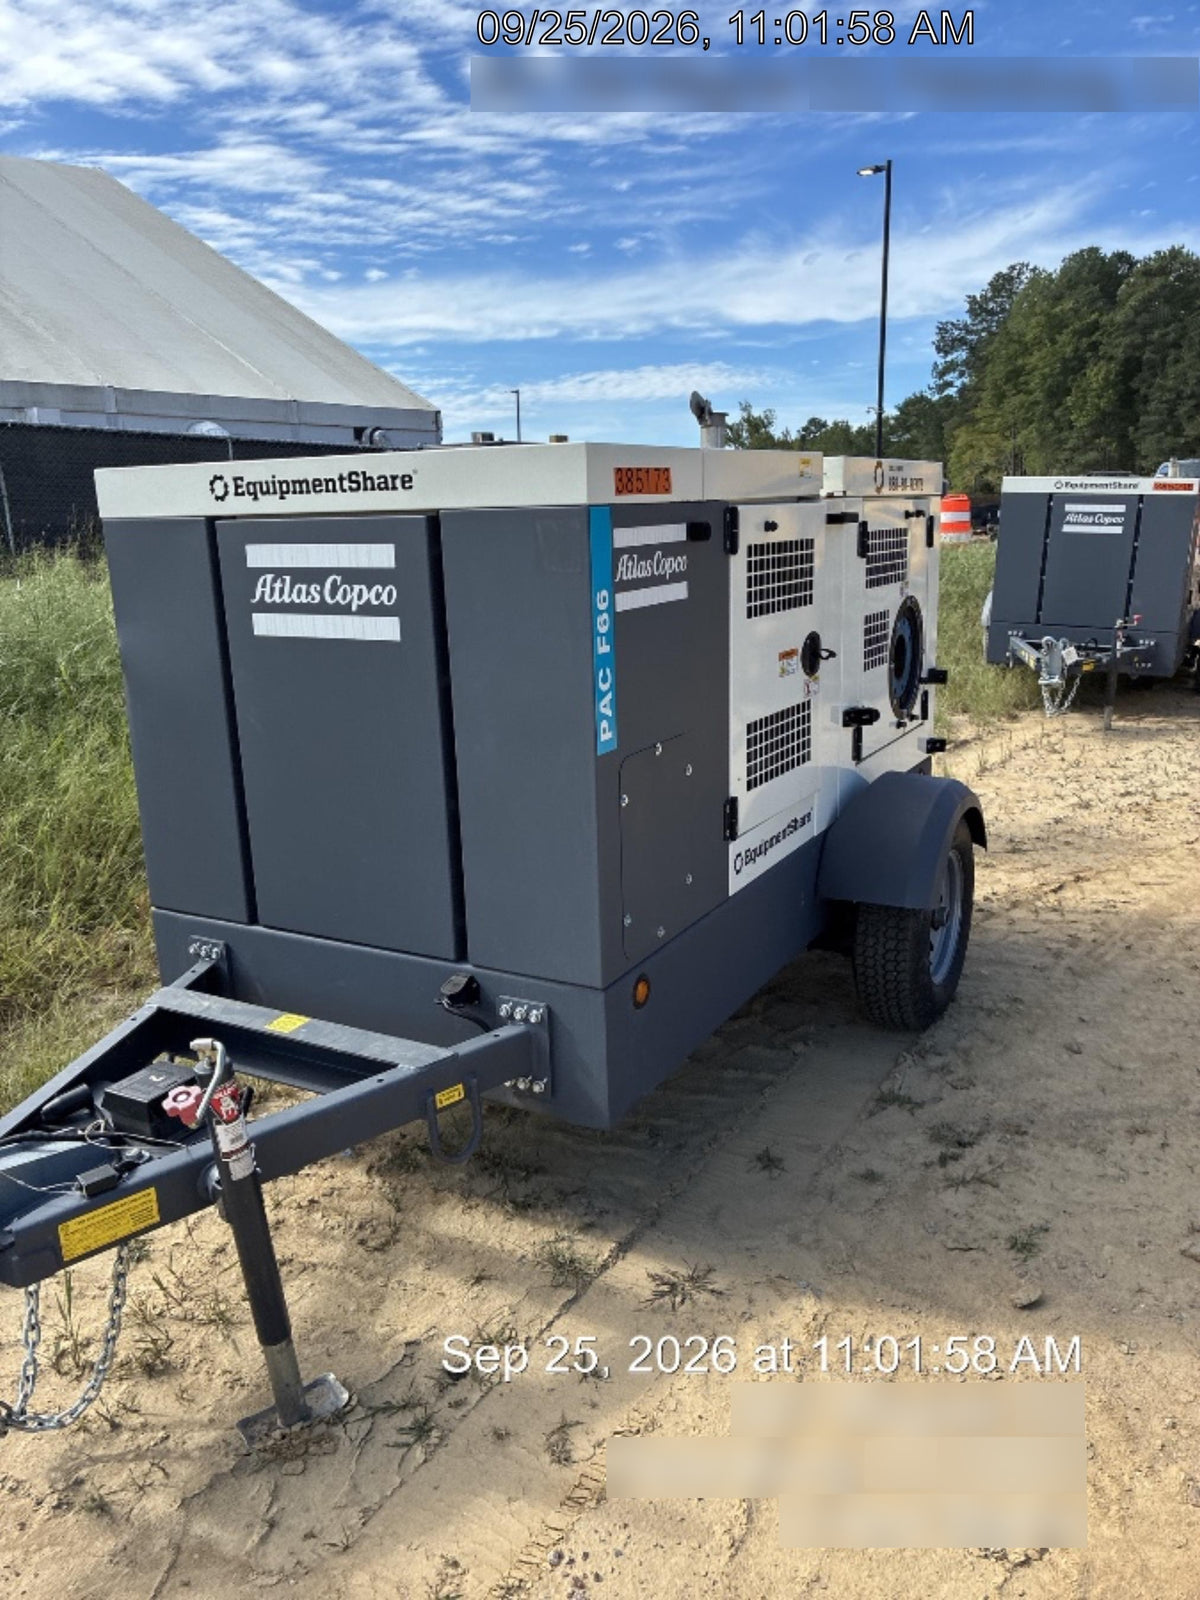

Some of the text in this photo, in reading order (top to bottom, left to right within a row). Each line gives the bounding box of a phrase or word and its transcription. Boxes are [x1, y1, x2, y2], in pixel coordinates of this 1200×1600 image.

[232, 470, 413, 500] EquipmentShare
[1064, 513, 1125, 524] Atlas Copco
[615, 551, 688, 582] Atlas Copco
[251, 573, 398, 612] Atlas Copco
[597, 667, 613, 742] PAC
[744, 811, 812, 866] EquipmentShare
